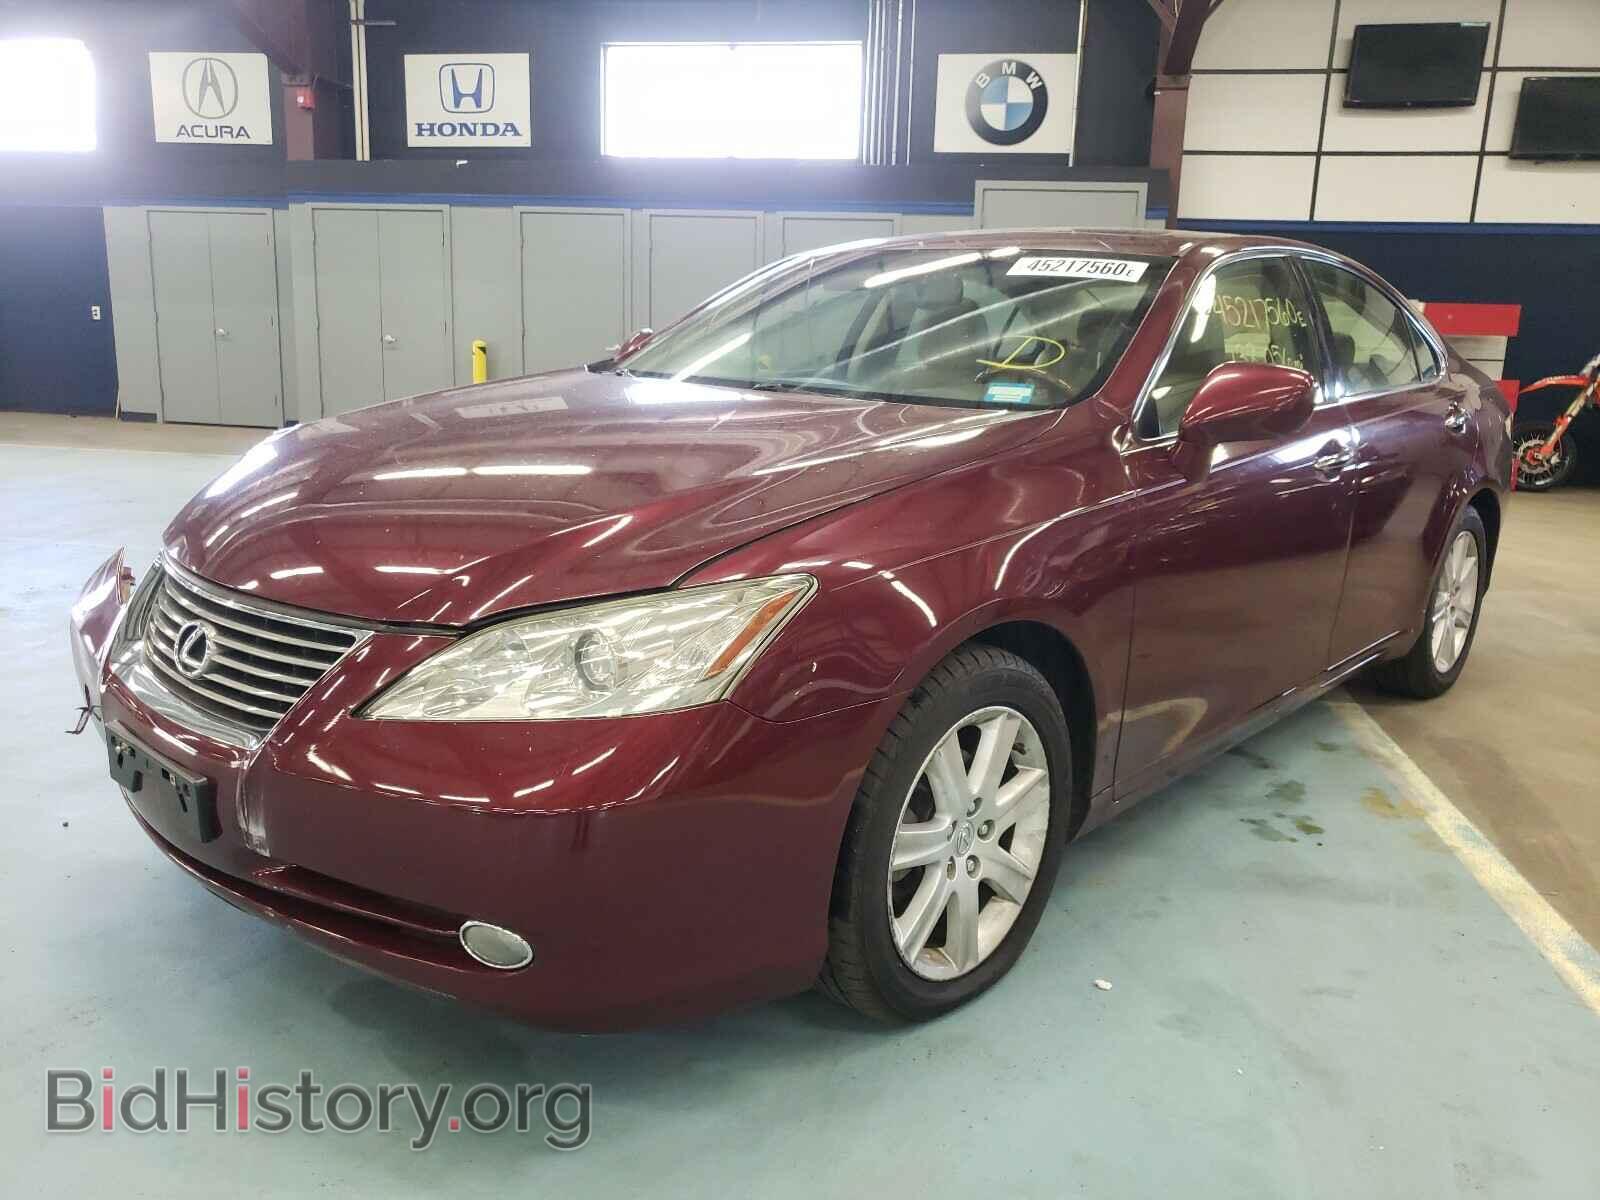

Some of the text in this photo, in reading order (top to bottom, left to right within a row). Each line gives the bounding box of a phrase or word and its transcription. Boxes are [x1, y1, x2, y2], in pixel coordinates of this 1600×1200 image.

[975, 61, 1043, 90] BMW
[175, 124, 251, 139] ACURA
[415, 122, 522, 137] HONDA
